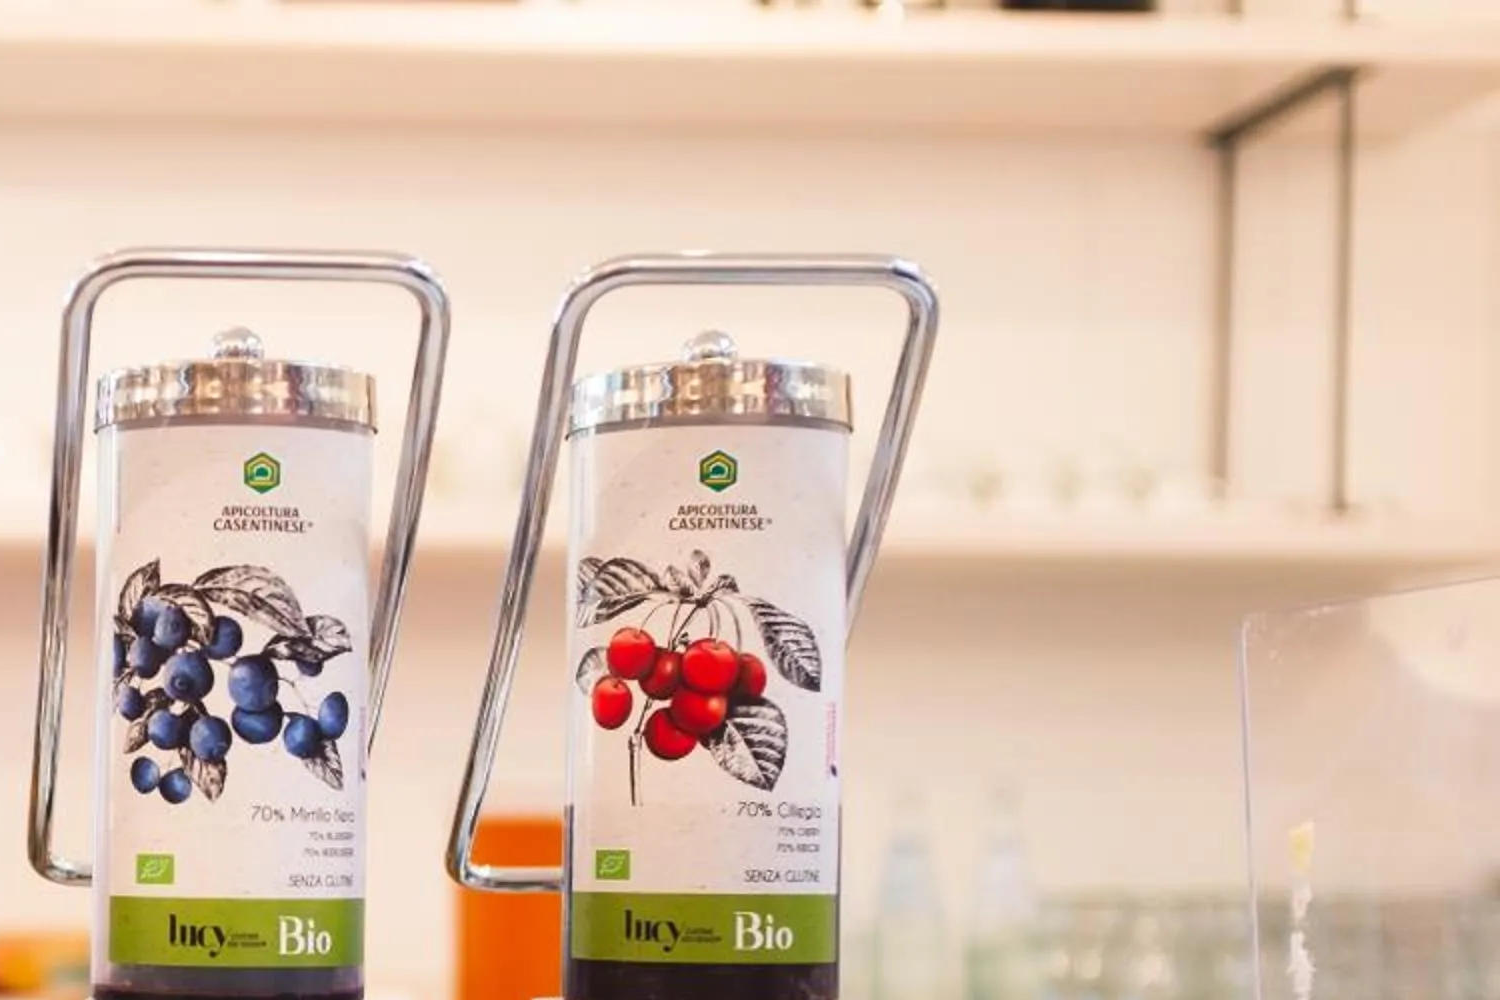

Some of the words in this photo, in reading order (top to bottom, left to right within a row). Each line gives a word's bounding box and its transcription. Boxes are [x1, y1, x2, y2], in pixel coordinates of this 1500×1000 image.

[222, 506, 299, 518] APICOLTURA
[678, 504, 758, 516] APICOLTURA
[251, 805, 285, 821] 70%
[738, 801, 772, 817] 70%
[744, 869, 780, 883] SENZA
[168, 913, 226, 958] lucy
[277, 915, 333, 956] Bio
[624, 909, 680, 953] lucy
[733, 911, 793, 951] Bio
